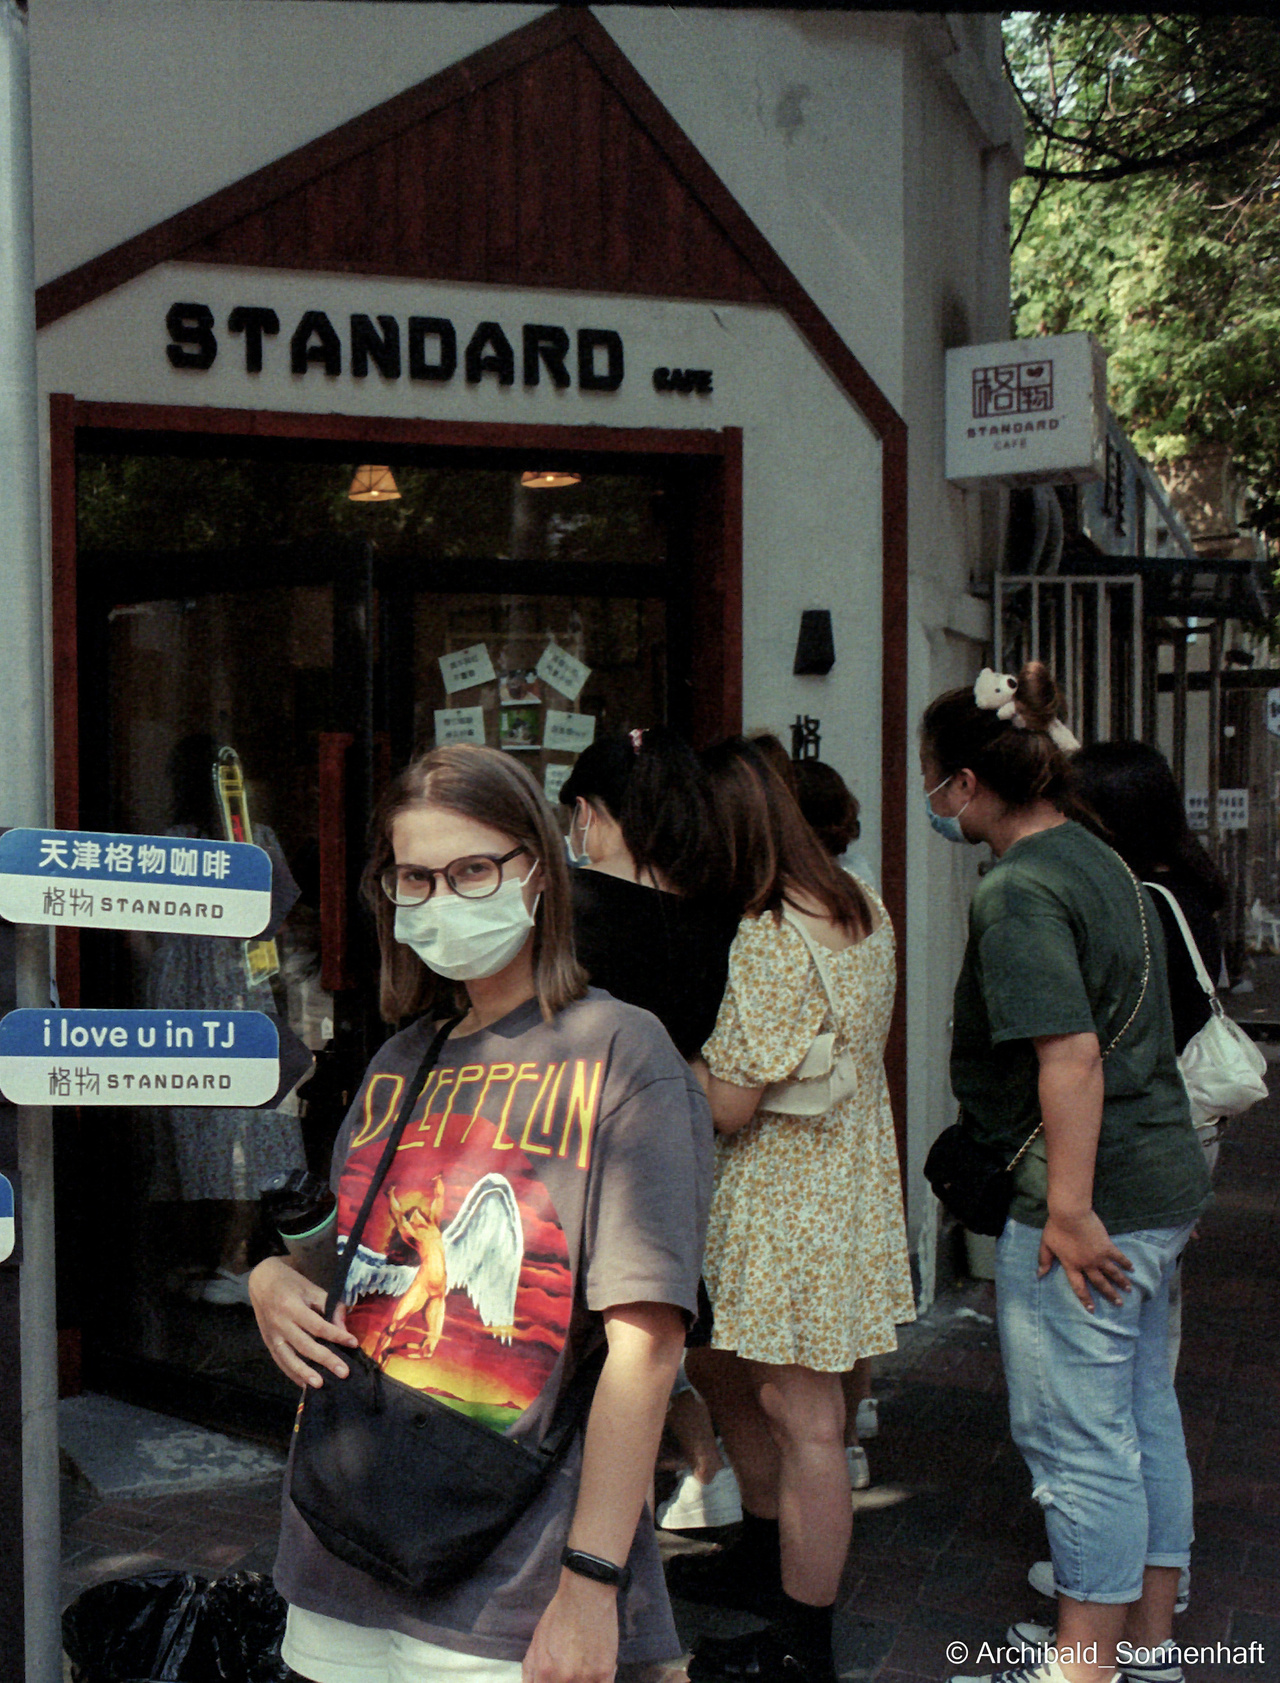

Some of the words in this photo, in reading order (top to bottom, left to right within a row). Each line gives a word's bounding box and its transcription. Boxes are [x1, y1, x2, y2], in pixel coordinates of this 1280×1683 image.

[166, 303, 624, 390] STANDARD
[973, 360, 1053, 418] 格物
[967, 419, 1059, 438] STANDARD
[994, 439, 1027, 450] CAFE
[38, 838, 231, 880] 天津格物咖啡
[42, 886, 94, 917] 格物
[100, 896, 224, 919] STANDARD
[43, 1018, 51, 1047] i
[61, 1018, 128, 1048] love
[137, 1027, 156, 1048] u
[165, 1019, 194, 1048] in
[202, 1021, 236, 1048] TJ
[48, 1066, 100, 1097] 格物
[107, 1074, 232, 1090] STANDARD
